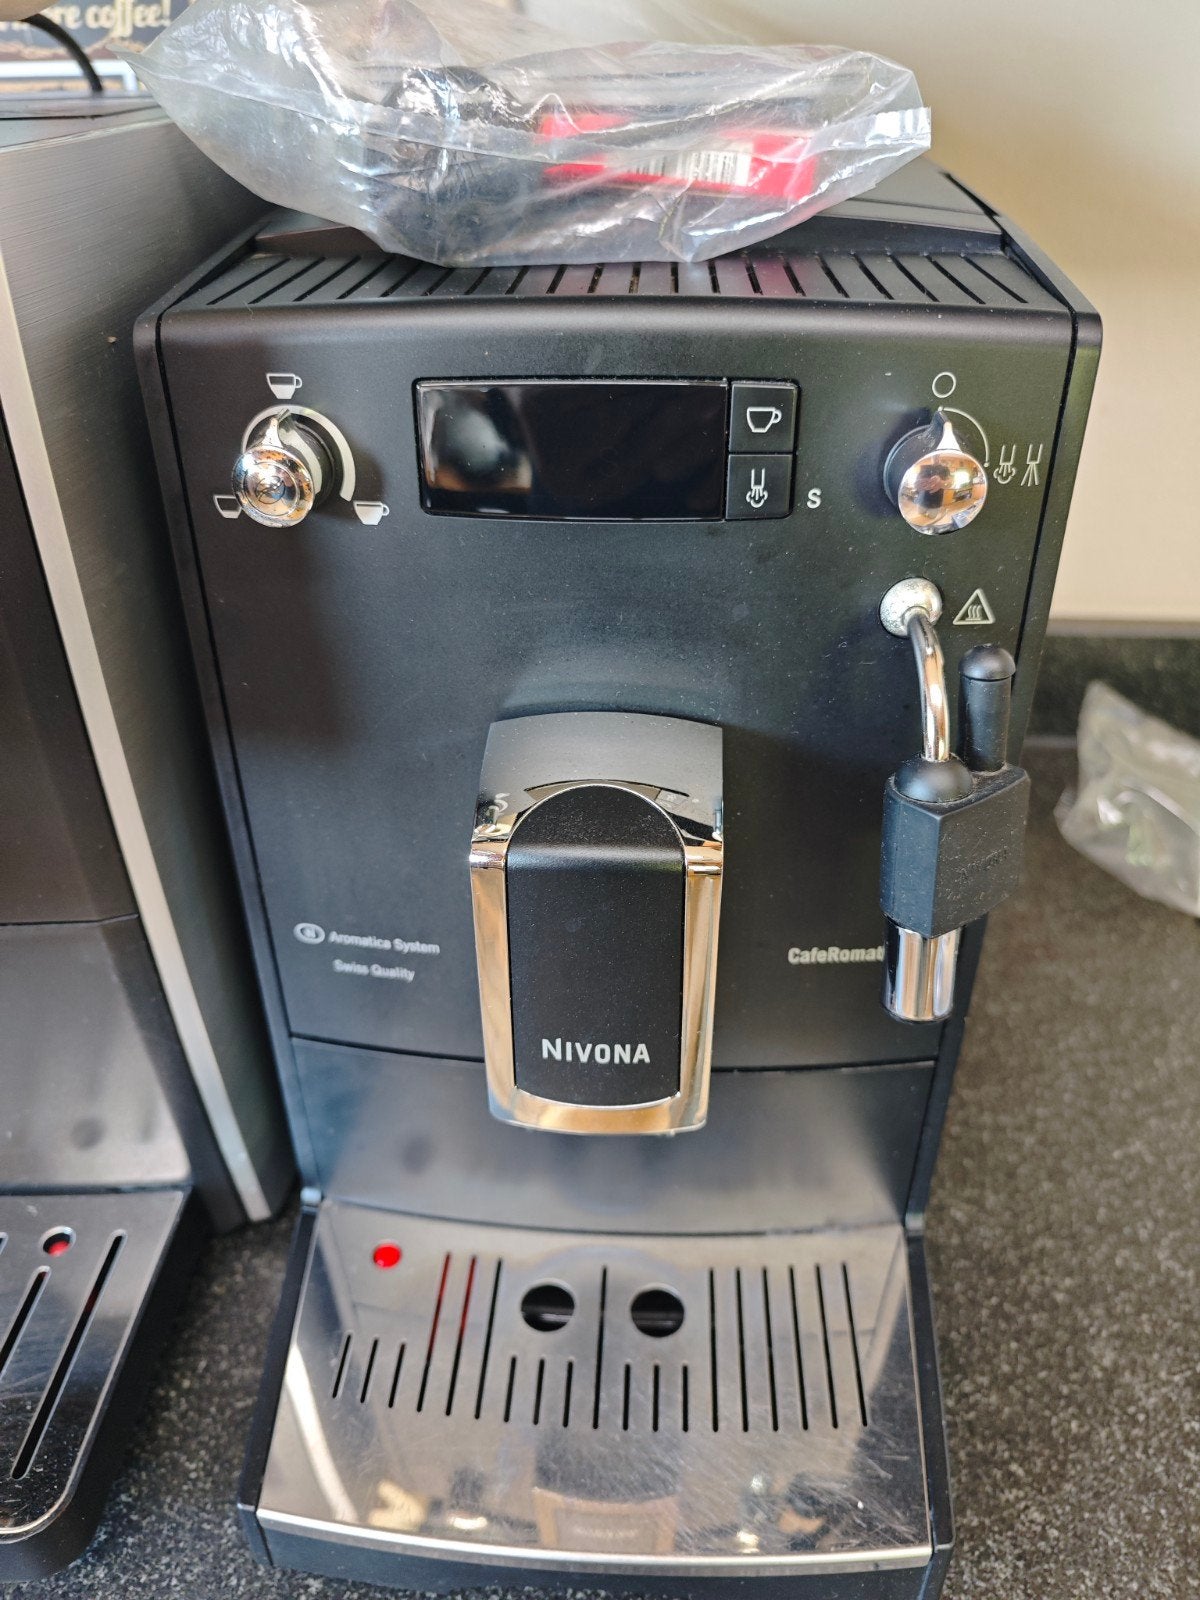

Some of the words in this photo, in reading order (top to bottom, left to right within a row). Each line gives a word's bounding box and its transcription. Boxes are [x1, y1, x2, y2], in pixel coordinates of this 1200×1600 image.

[85, 0, 171, 37] coffee!
[806, 488, 822, 509] S
[328, 930, 391, 950] Aromatica
[392, 938, 440, 955] System
[333, 959, 369, 976] Swiss
[370, 964, 415, 983] Quality
[541, 1037, 651, 1065] NIVONA
